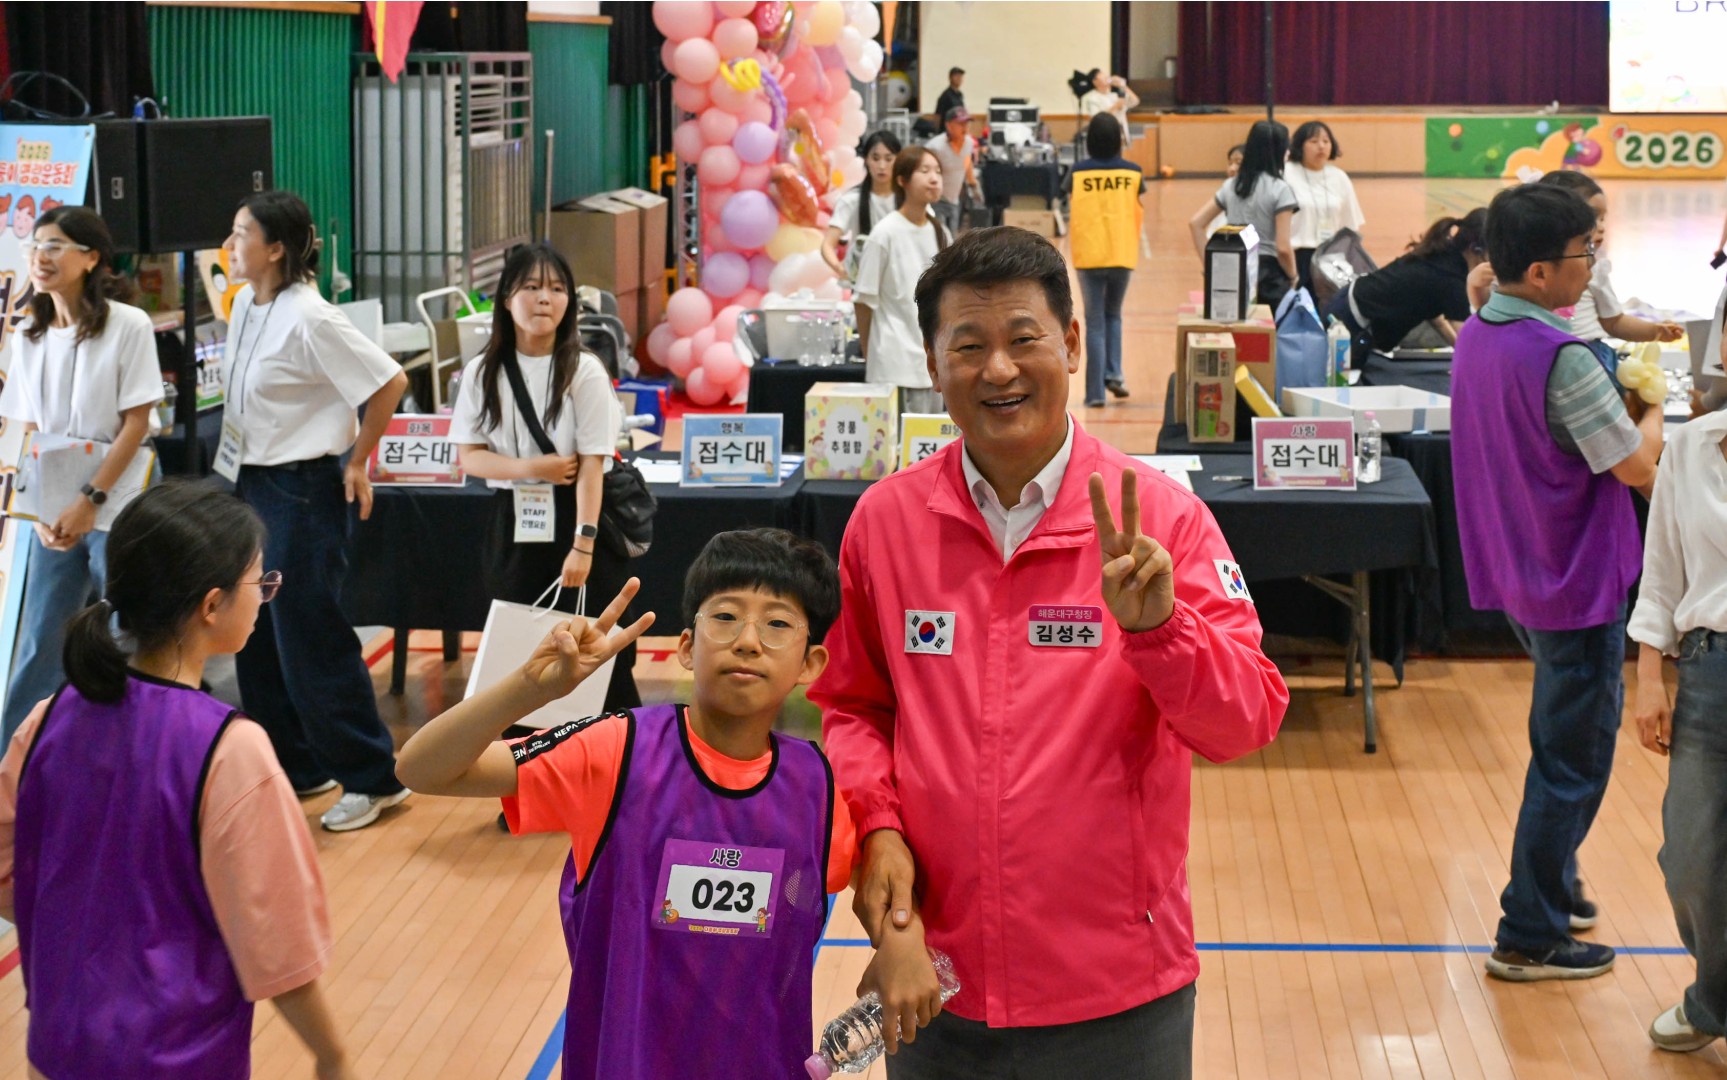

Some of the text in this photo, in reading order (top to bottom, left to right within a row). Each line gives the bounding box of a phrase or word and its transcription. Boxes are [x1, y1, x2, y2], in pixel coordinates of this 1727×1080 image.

[1624, 135, 1715, 164] 2026
[1083, 176, 1132, 192] STAFF
[408, 422, 432, 434] 화목
[721, 422, 744, 434] 행복
[837, 421, 856, 434] 경품
[1291, 424, 1316, 437] 사랑
[384, 441, 452, 464] 접수대
[698, 441, 766, 464] 접수대
[1271, 444, 1339, 468] 접수대
[522, 508, 547, 516] STAFF
[1037, 608, 1093, 620] 해운대구청장
[1035, 624, 1095, 643] 김성수
[553, 723, 579, 739] NEPA
[709, 848, 742, 867] 사랑
[691, 878, 756, 914] 023
